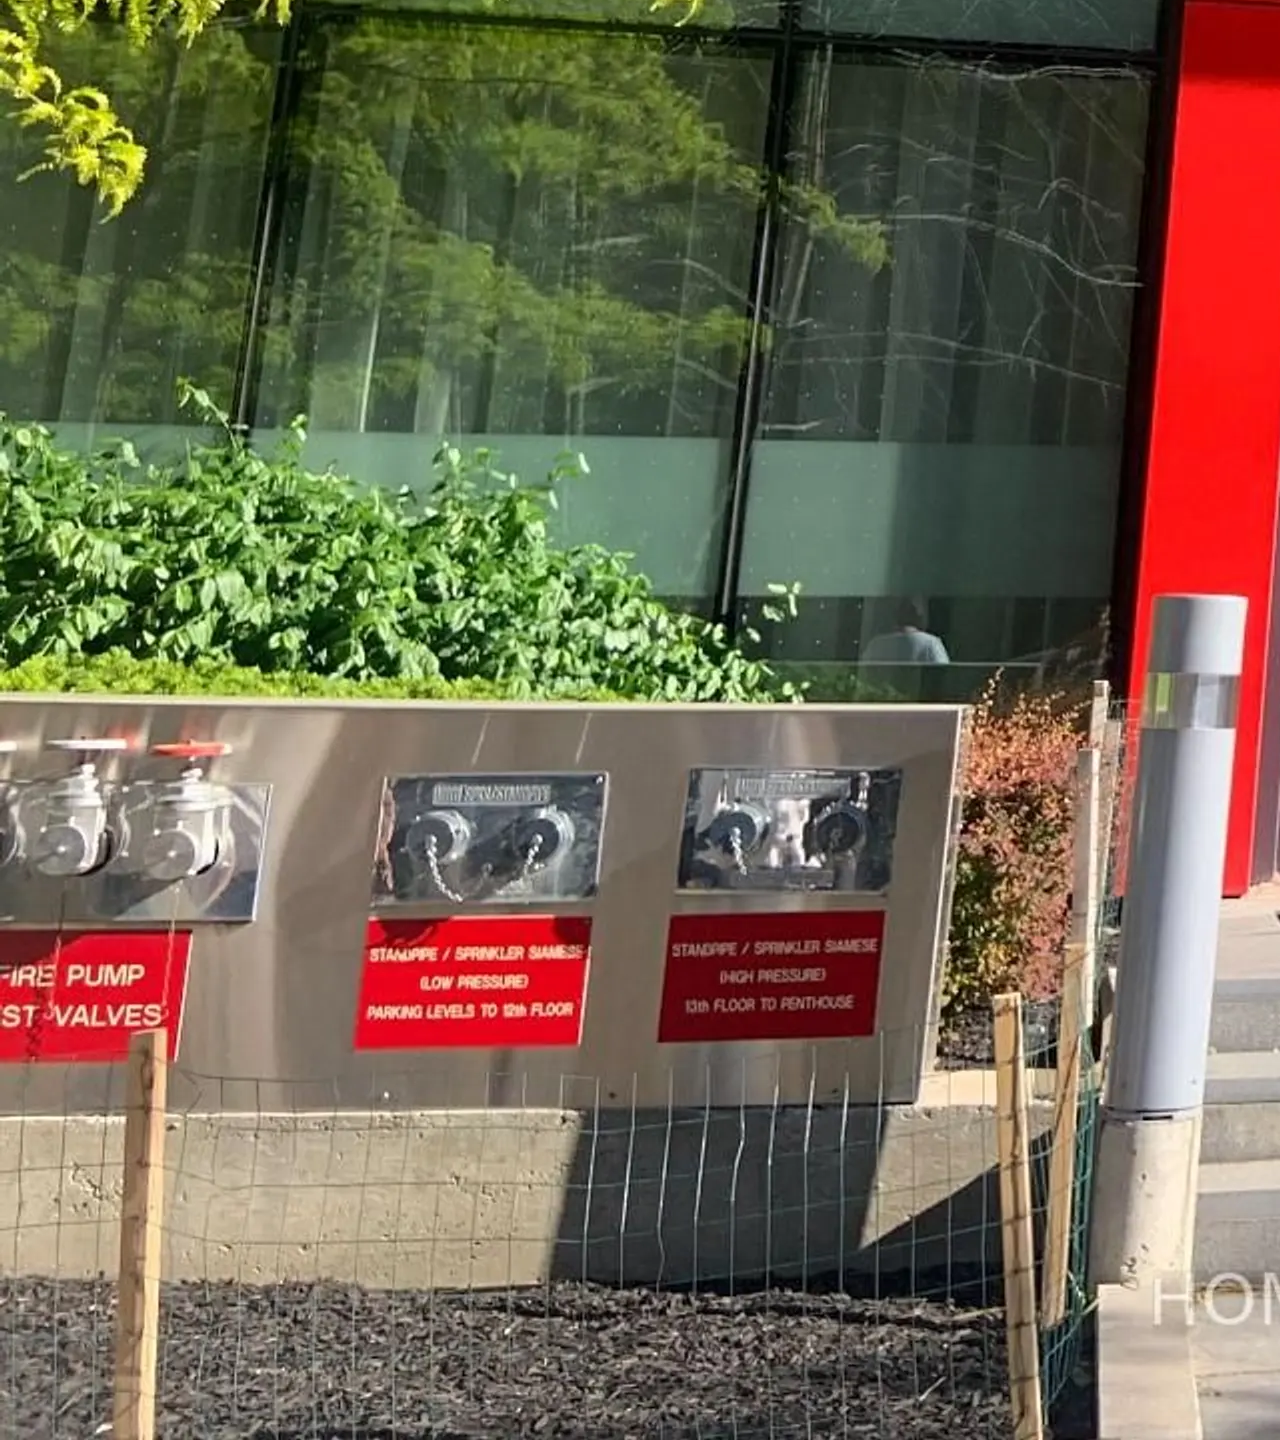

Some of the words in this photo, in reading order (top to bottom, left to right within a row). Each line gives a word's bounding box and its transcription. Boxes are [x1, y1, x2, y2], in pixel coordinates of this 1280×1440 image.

[369, 947, 438, 962] STANDPIPE
[454, 945, 524, 961] SPRINKLER
[672, 941, 737, 957] STANDPIPE
[754, 940, 820, 956] SPRINKLER
[824, 938, 879, 953] SIAMESE
[66, 963, 146, 988] PUMP
[420, 975, 453, 991] (LOW
[456, 974, 529, 990] PRESSURE)
[366, 1006, 422, 1020] PARKING
[427, 1004, 475, 1019] LEVELS
[481, 1003, 498, 1018] TO
[502, 1003, 527, 1018] 12th
[530, 1002, 575, 1017] FLOOR
[713, 997, 756, 1013] FLOOR
[760, 996, 777, 1011] TO
[780, 994, 855, 1011] PENTHOUSE
[0, 1004, 39, 1028] ST
[54, 1004, 162, 1028] VALVES
